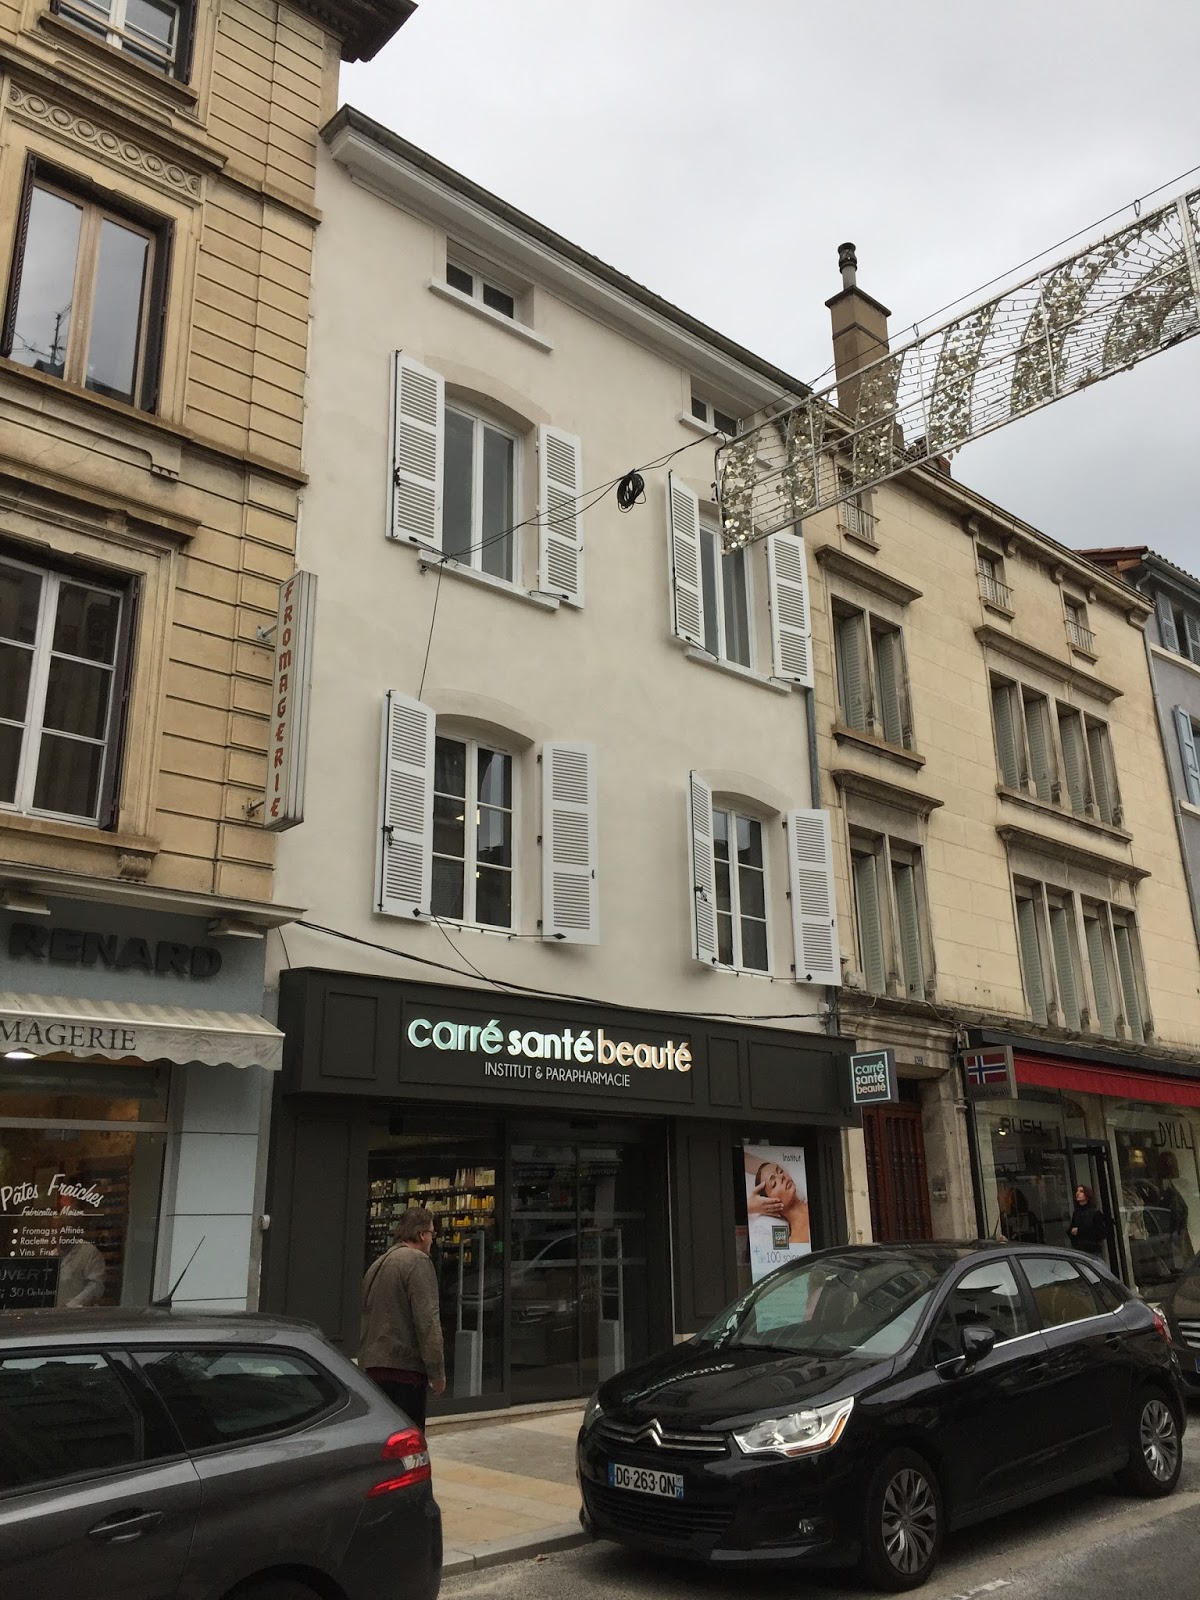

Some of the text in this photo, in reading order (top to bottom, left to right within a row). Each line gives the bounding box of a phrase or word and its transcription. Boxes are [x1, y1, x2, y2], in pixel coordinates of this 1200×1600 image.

[270, 580, 294, 817] FROMAGERIE
[9, 923, 222, 978] RENARD
[0, 1020, 136, 1051] MAGERIE
[407, 1018, 692, 1072] carré santé beauté
[485, 1062, 631, 1087] INSTITUT & PARAPHARMACIE
[855, 1061, 884, 1075] carré
[856, 1071, 885, 1085] santé
[856, 1082, 886, 1094] beauté
[0, 1173, 104, 1211] Pâtes Fraîches
[60, 1206, 85, 1216] Maison
[9, 1287, 24, 1298] 30
